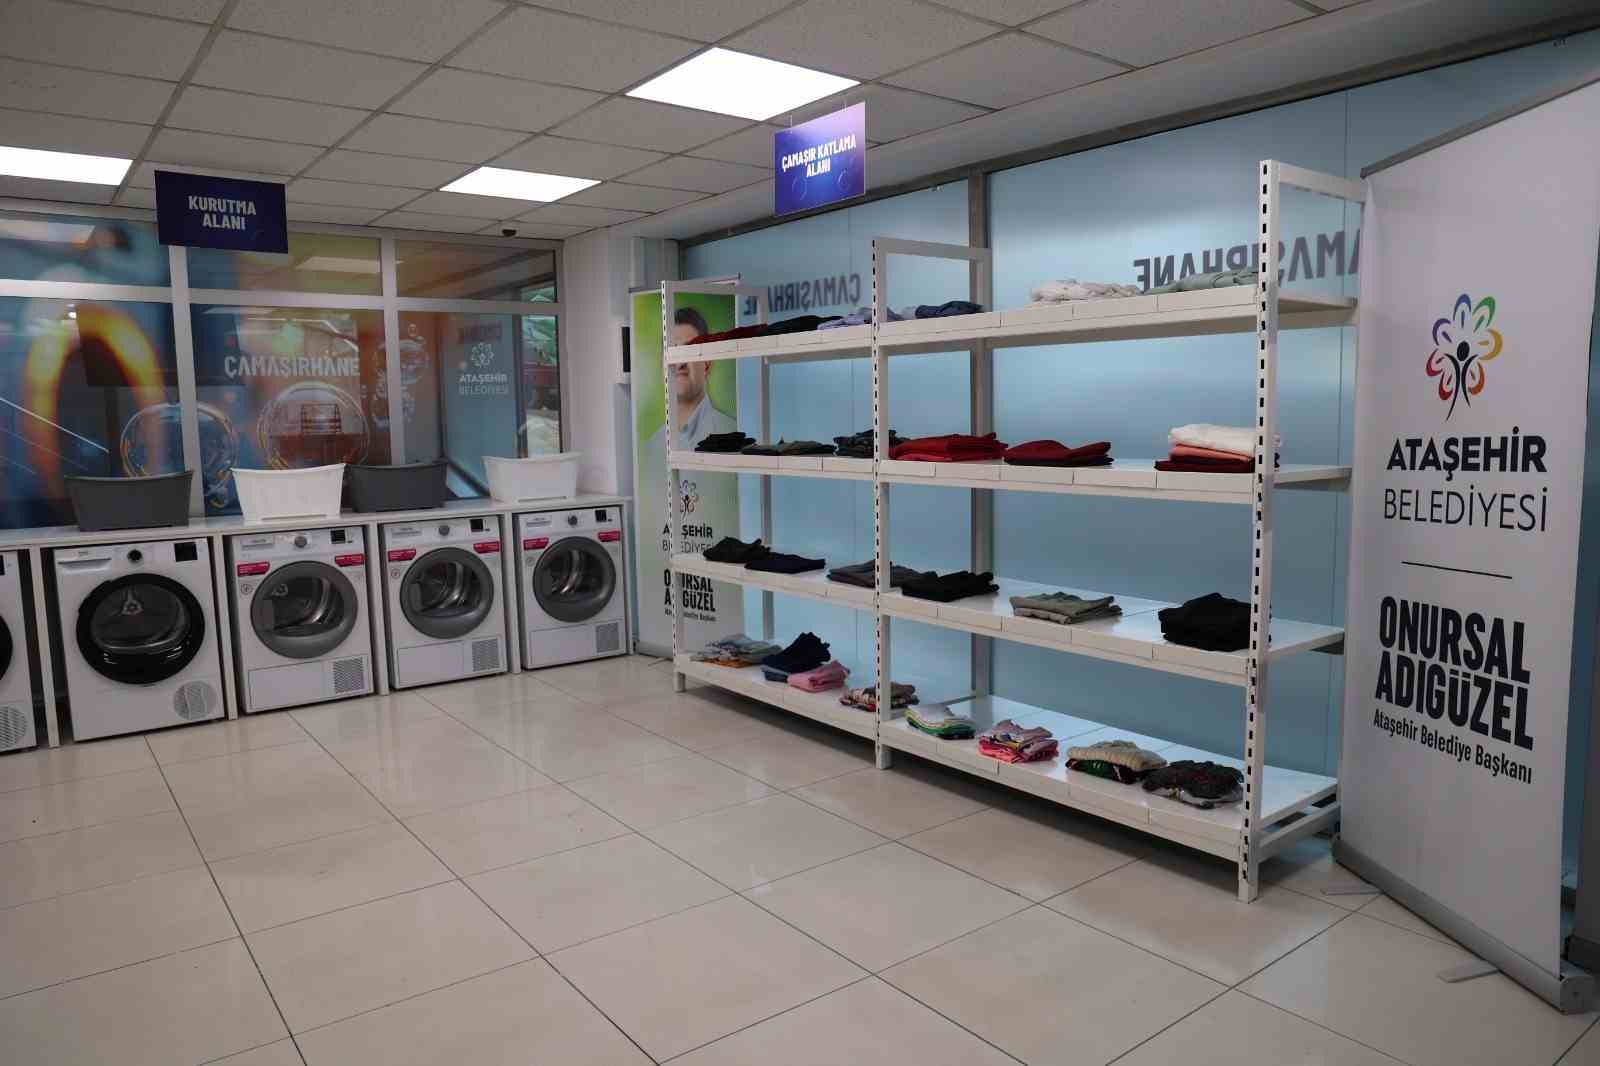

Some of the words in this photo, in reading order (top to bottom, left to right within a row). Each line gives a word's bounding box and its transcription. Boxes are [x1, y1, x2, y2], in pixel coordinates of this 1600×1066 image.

[782, 147, 816, 173] ÇAMAŞIR
[817, 134, 857, 159] KATLAMA
[806, 157, 831, 178] ALANI
[188, 195, 257, 215] KURUTMA
[202, 213, 246, 230] ALANI
[224, 355, 361, 379] ÇAMAŞIRHANE
[1386, 425, 1548, 482] ATAŞEHİR
[1384, 484, 1548, 532] BELEDİYESİ
[663, 523, 713, 540] AŞEHİR
[664, 588, 716, 612] AGÜZEL
[1379, 596, 1531, 685] ONURSAL
[1375, 650, 1534, 751] ADIGÜZEL
[1373, 708, 1419, 742] Ataşehir
[1420, 724, 1472, 763] Belediye
[1475, 744, 1533, 785] Başkanı
